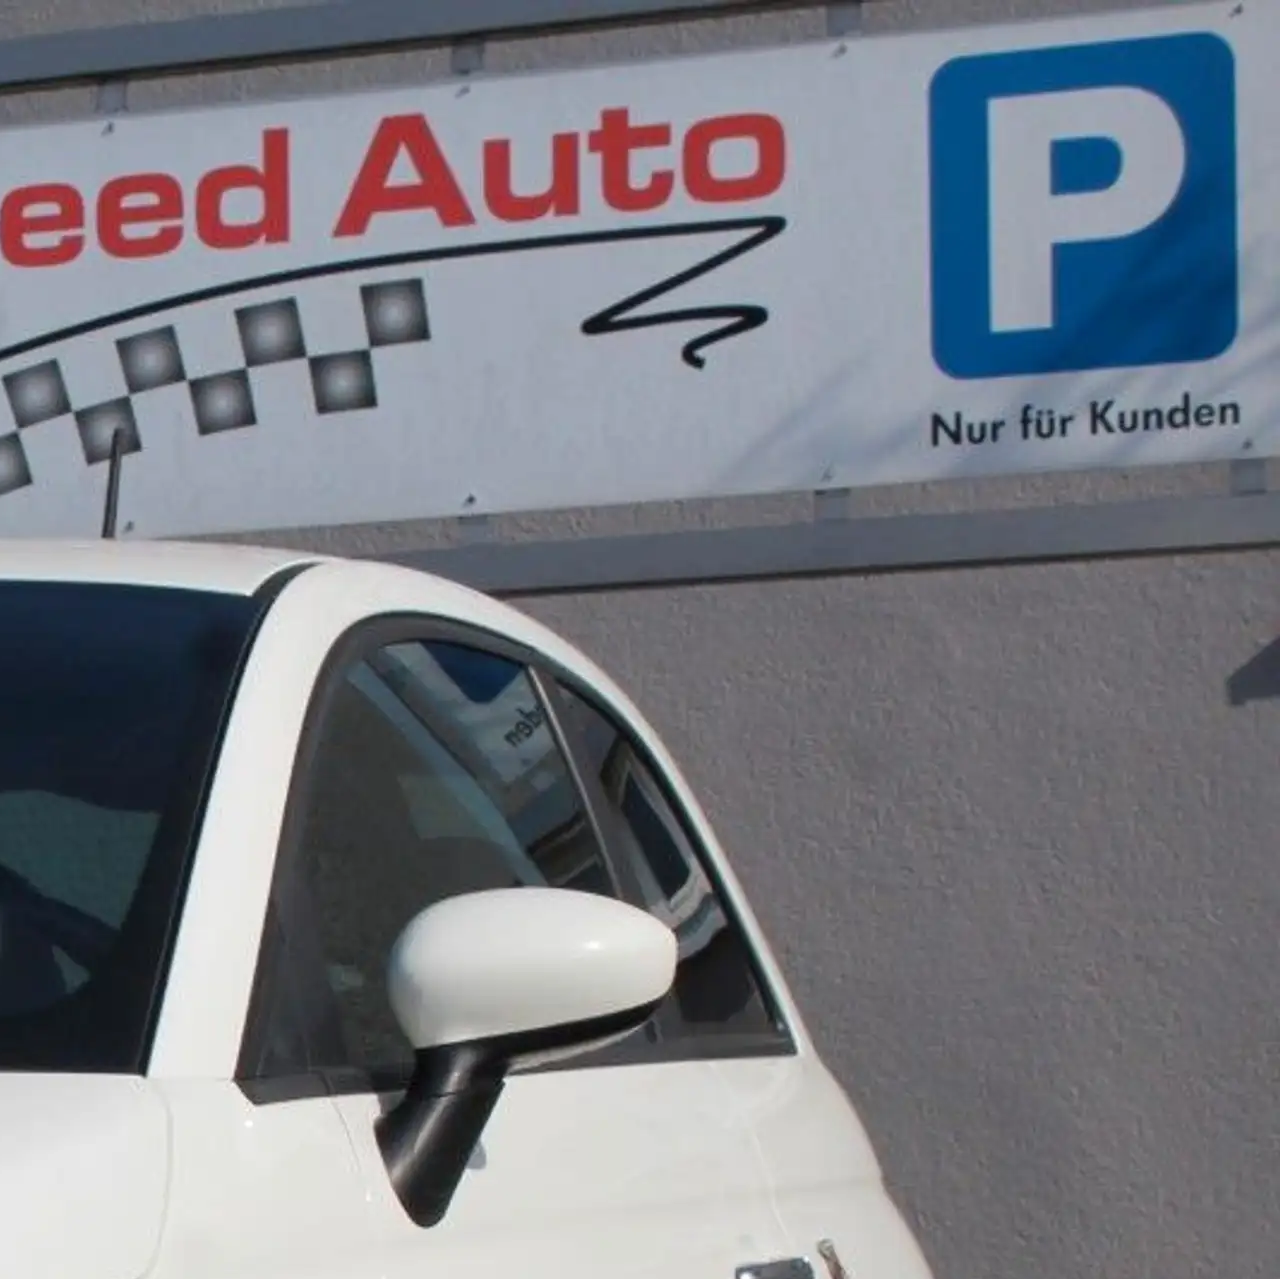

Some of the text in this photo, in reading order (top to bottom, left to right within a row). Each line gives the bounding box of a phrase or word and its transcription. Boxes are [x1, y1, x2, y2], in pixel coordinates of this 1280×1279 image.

[331, 106, 788, 239] Auto
[986, 84, 1187, 335] P
[930, 391, 1241, 447] Nur für Kunden
